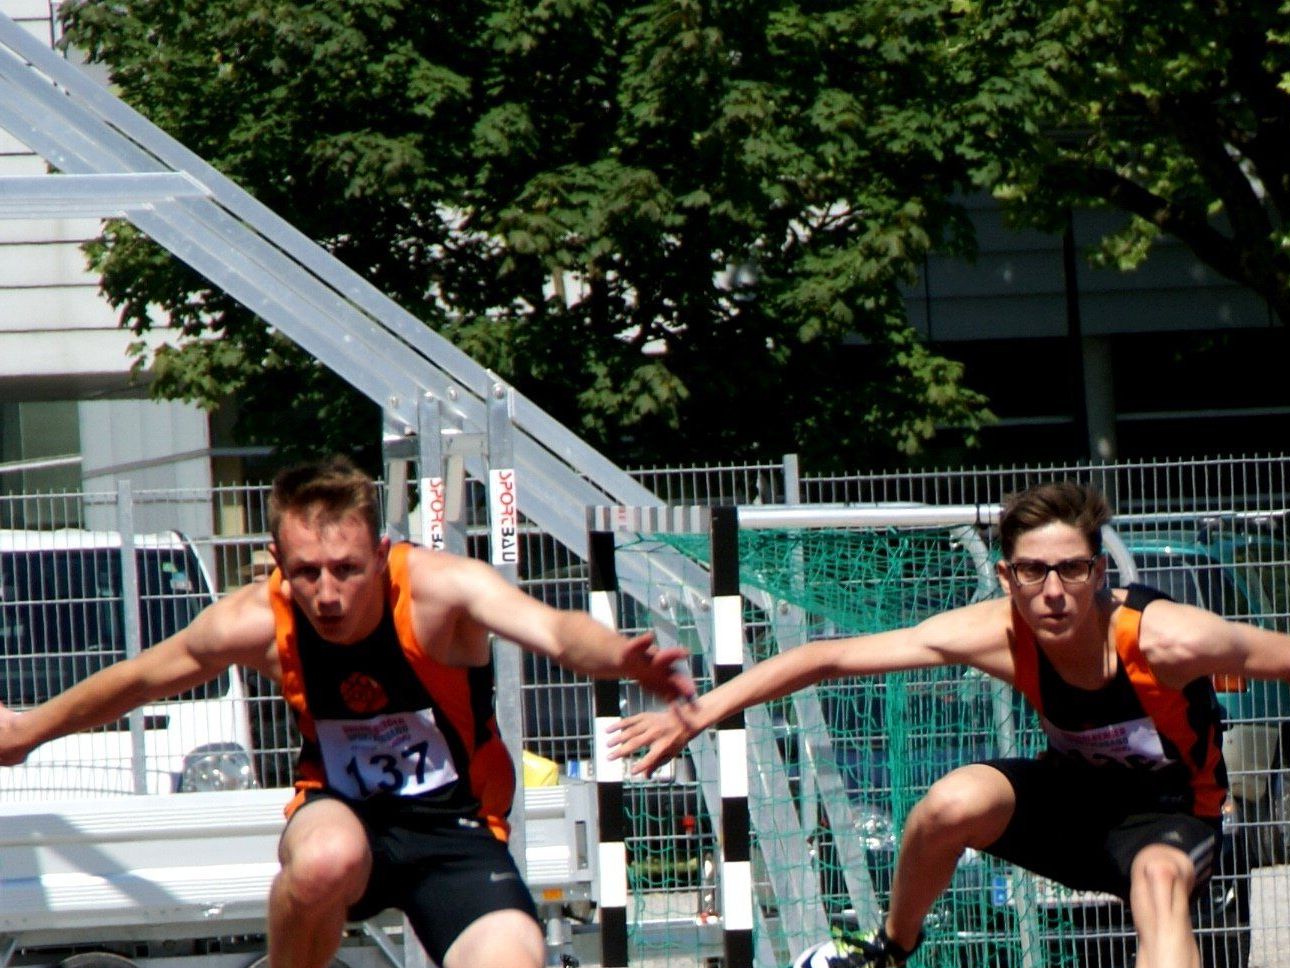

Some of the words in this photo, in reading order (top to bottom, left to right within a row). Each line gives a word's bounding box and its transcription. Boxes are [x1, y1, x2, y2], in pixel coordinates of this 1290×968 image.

[430, 479, 444, 549] SPORTB
[499, 471, 516, 562] SPORTBAU
[346, 740, 428, 796] 137
